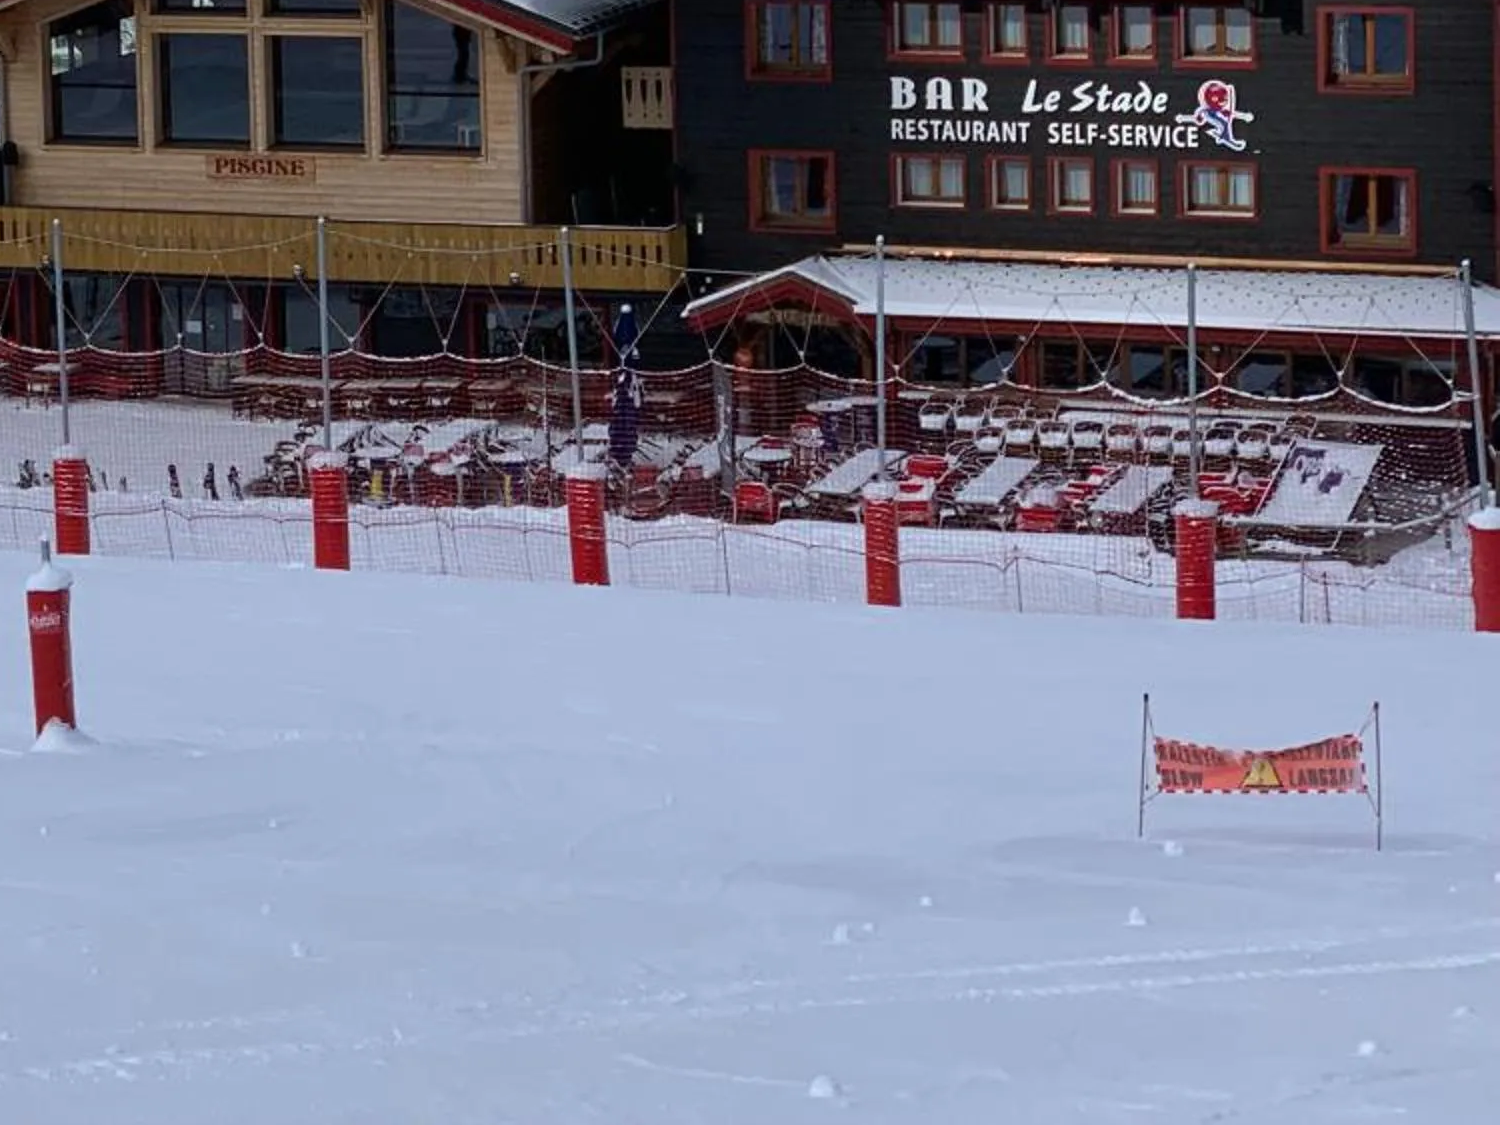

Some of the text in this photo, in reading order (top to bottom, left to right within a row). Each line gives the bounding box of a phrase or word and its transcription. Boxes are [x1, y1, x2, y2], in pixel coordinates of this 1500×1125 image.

[890, 76, 1169, 114] BAR Le Stade
[890, 119, 1199, 149] RESTAURANT SELF-SERVICE
